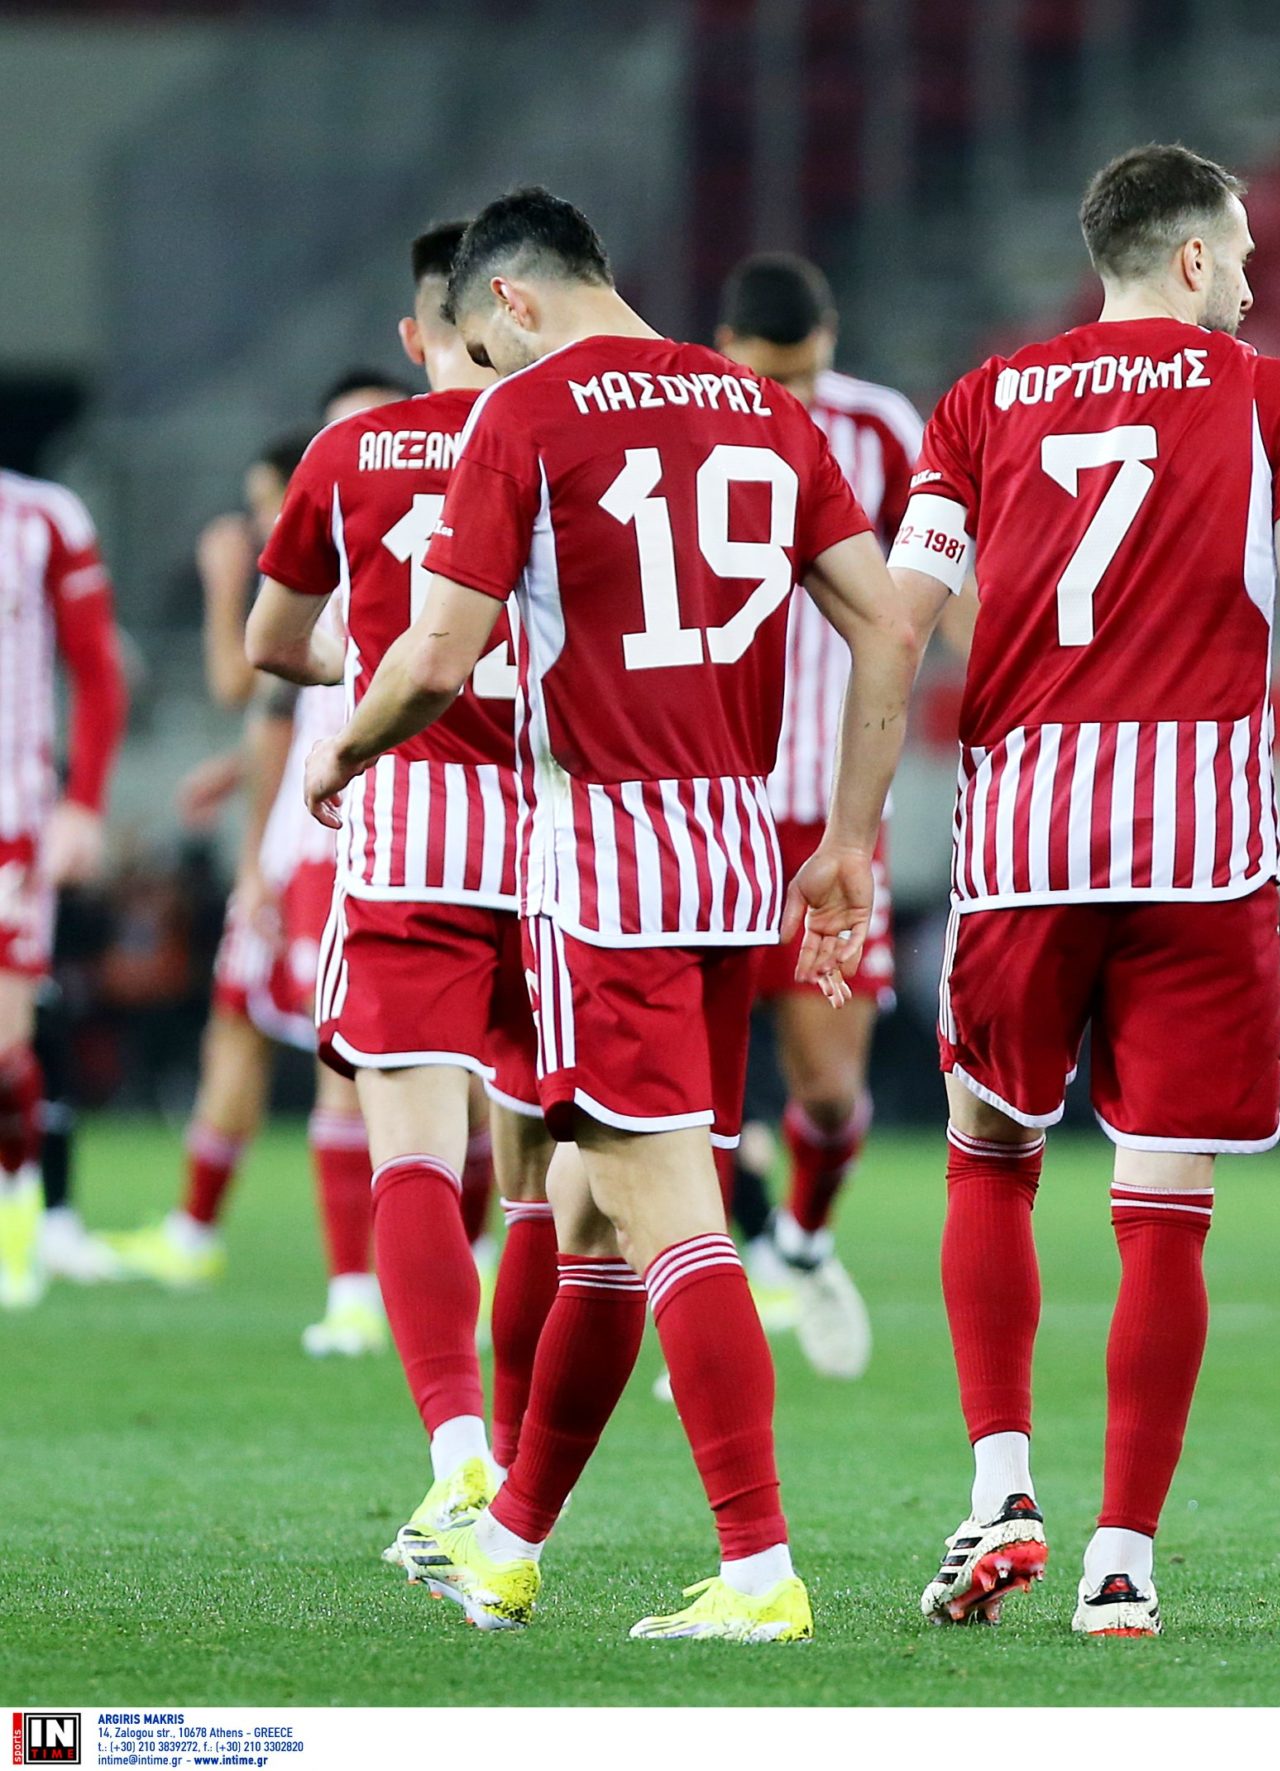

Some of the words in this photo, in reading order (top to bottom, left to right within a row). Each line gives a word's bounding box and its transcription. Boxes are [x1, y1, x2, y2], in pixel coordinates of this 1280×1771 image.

[567, 370, 773, 417] ΜΑΣΟΥΡΑΣ
[599, 443, 799, 671] 19
[1041, 424, 1159, 647] 7
